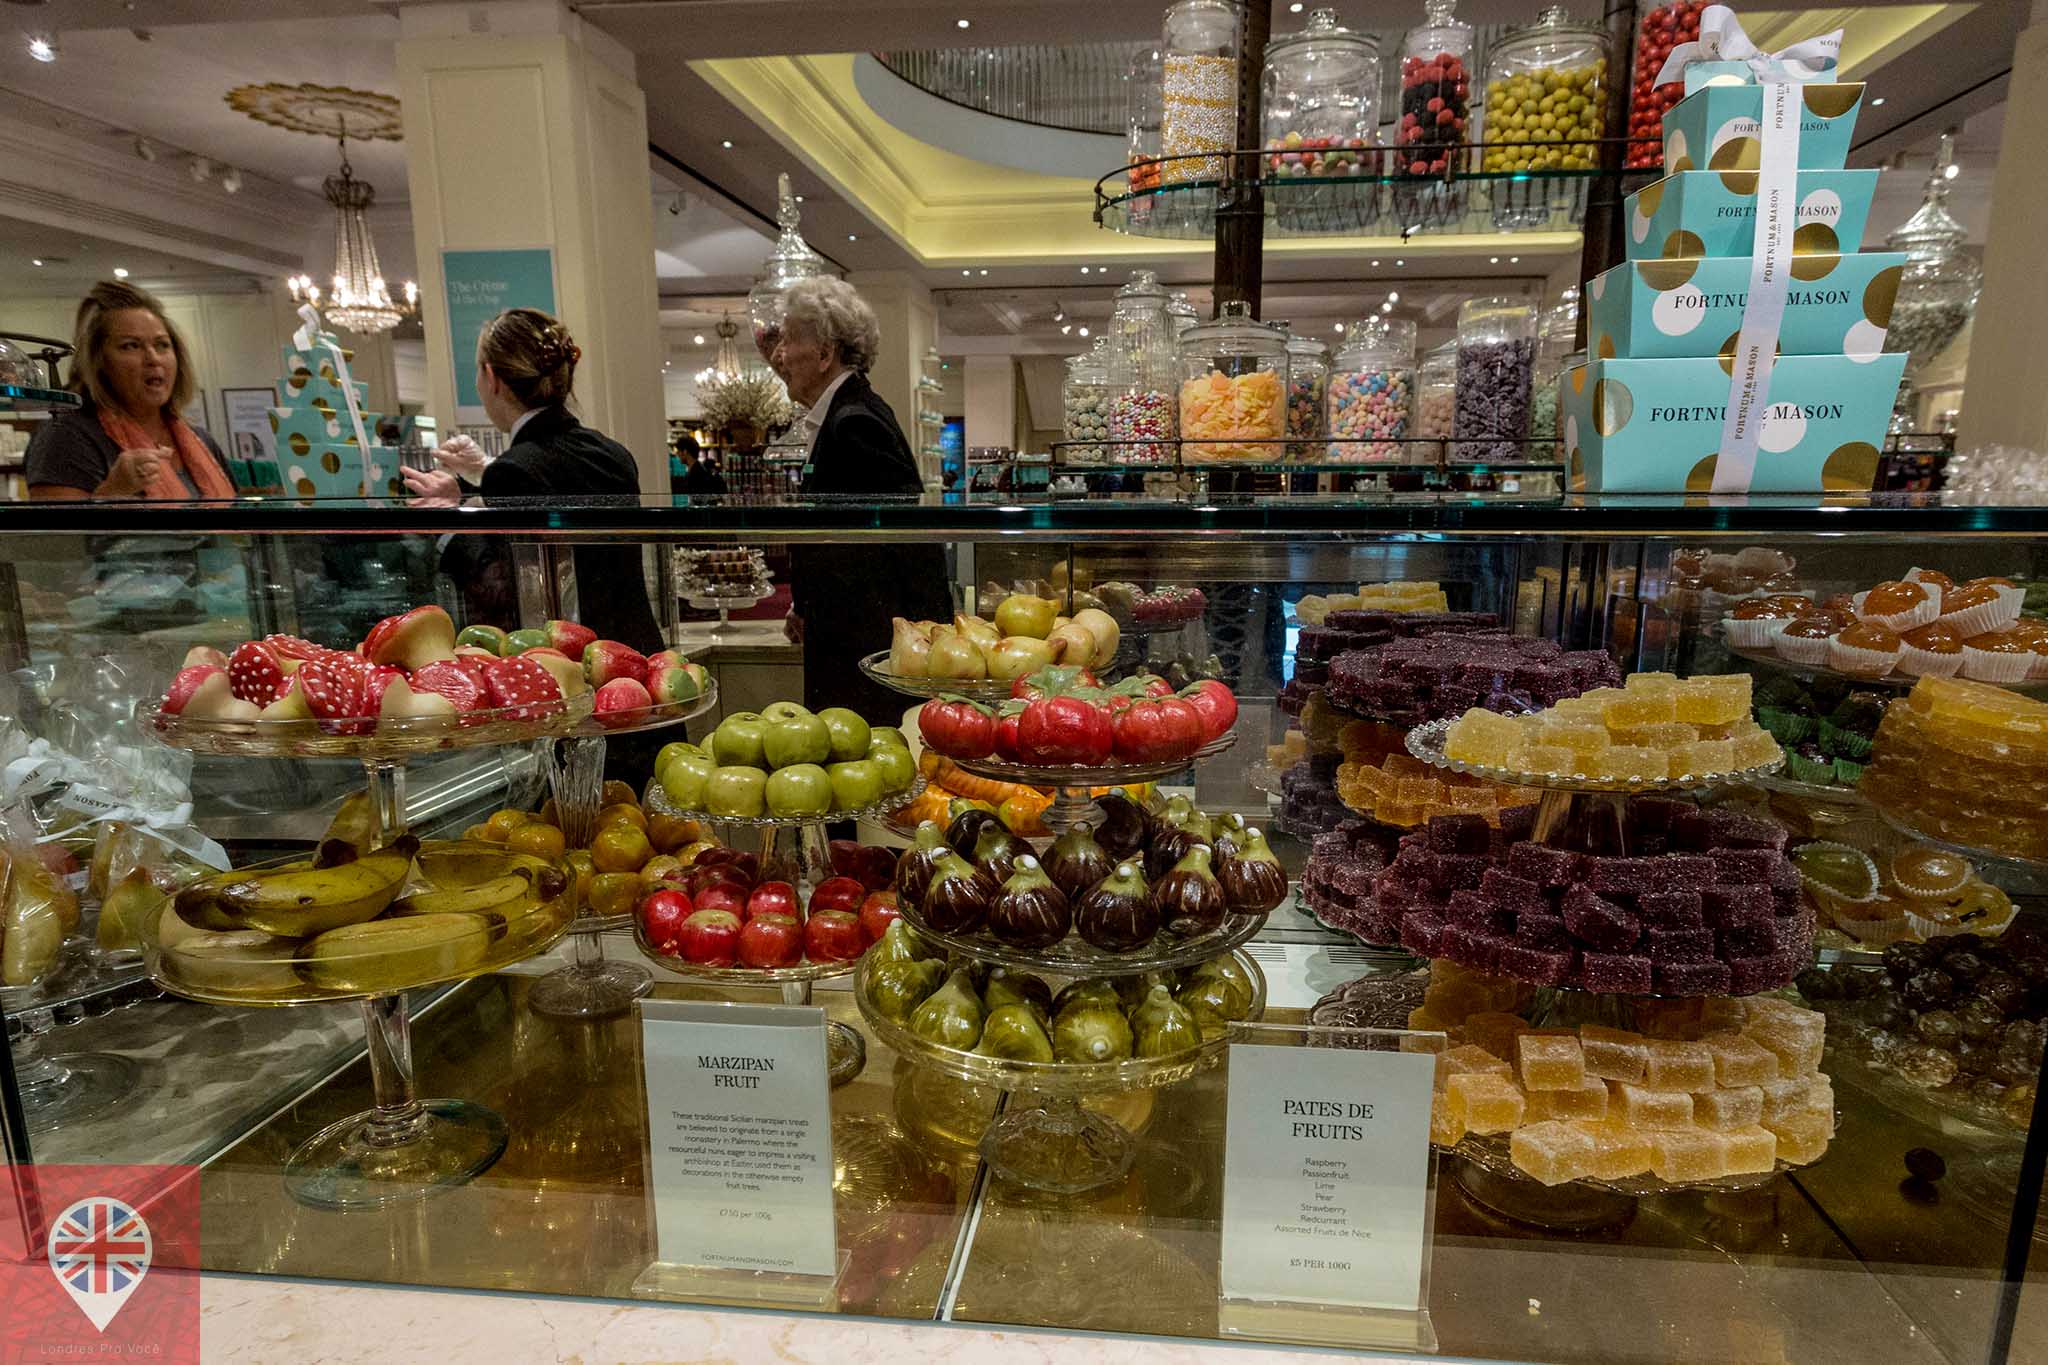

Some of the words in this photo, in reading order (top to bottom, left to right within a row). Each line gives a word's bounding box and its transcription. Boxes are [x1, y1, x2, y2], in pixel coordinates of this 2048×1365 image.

[1734, 123, 1761, 133] FORT
[1795, 205, 1839, 217] MASON
[1674, 293, 1749, 309] FORTNU
[1786, 290, 1851, 306] MASON
[1774, 404, 1845, 420] MASON
[698, 1055, 776, 1072] MARZIPAN
[714, 1075, 760, 1089] FRUIT
[1283, 1100, 1343, 1118] PATES
[1348, 1104, 1374, 1119] DE
[672, 1112, 693, 1120] These
[694, 1113, 729, 1122] traditional
[730, 1114, 753, 1123] Sicilian
[755, 1116, 787, 1126] marzipan
[689, 1124, 718, 1132] believed
[729, 1127, 760, 1135] originate
[787, 1129, 805, 1138] single
[1292, 1122, 1364, 1141] FRUITS
[685, 1136, 721, 1145] monastery
[731, 1137, 760, 1145] Palermo
[668, 1145, 706, 1153] resourceful
[727, 1150, 746, 1158] eager
[758, 1151, 784, 1159] impress
[684, 1158, 721, 1167] archbishop
[755, 1161, 771, 1169] used
[773, 1162, 792, 1170] them
[1305, 1158, 1347, 1169] Raspberry
[682, 1169, 722, 1177] decorations
[732, 1171, 744, 1179] the
[746, 1173, 780, 1181] otherwise
[781, 1176, 804, 1184] empty
[1302, 1169, 1350, 1179] Passionfruit
[726, 1182, 741, 1190] fruit
[1315, 1182, 1335, 1190] Lime
[1315, 1193, 1334, 1201] Pear
[1300, 1203, 1346, 1215] Strawberry
[740, 1211, 752, 1220] per
[1300, 1215, 1346, 1225] Redcurrant
[1274, 1225, 1311, 1234] Assorted
[1313, 1226, 1336, 1236] Fruits
[1339, 1229, 1349, 1237] de
[1352, 1230, 1372, 1239] Nice
[1304, 1259, 1325, 1269] PER
[1328, 1261, 1351, 1271] 100G
